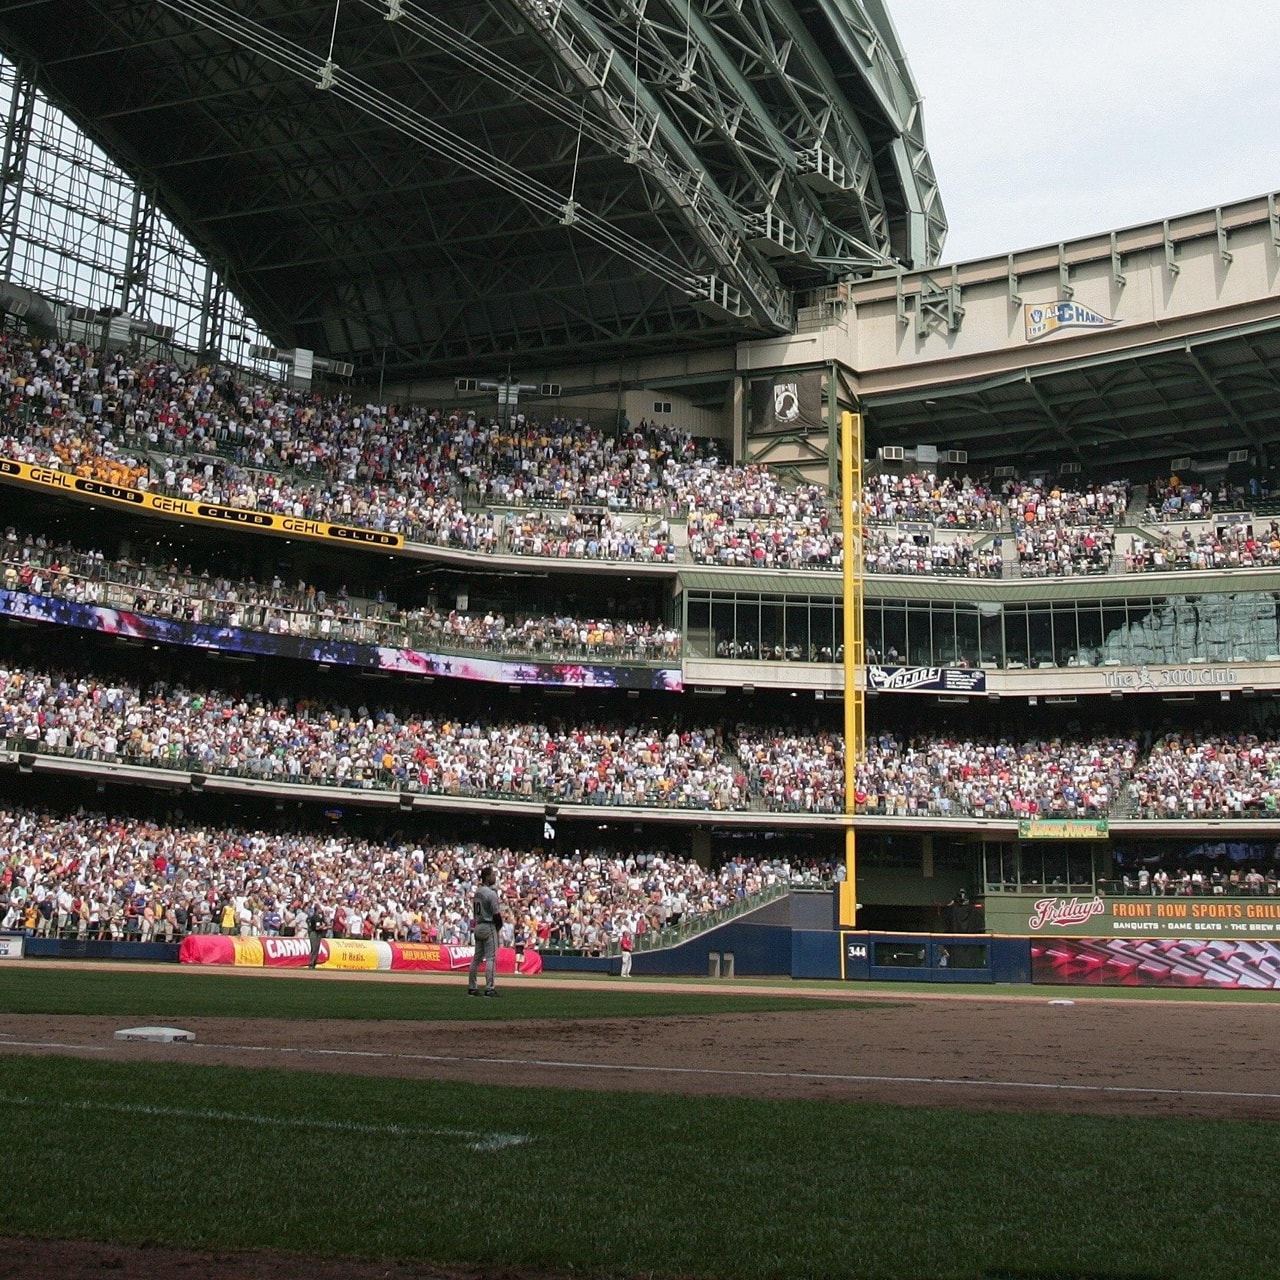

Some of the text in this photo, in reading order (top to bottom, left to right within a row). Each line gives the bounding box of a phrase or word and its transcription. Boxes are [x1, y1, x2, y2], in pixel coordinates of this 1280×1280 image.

[30, 468, 71, 487] GEHL
[84, 482, 135, 500] CLUB
[152, 497, 193, 514] GEHL
[208, 508, 263, 524] CLUB
[282, 520, 324, 535] GEHL
[337, 529, 389, 543] CLUB
[1103, 668, 1237, 687] The 300 Club
[1029, 896, 1105, 930] Friday's
[1112, 904, 1152, 917] FRONT
[1157, 904, 1187, 917] ROW
[1191, 904, 1242, 918] SPORTS
[1113, 922, 1158, 930] BANQUETS
[1250, 923, 1274, 931] BREW
[266, 939, 317, 958] CARM
[402, 950, 441, 962] MILWAUKEE
[849, 946, 865, 956] 344
